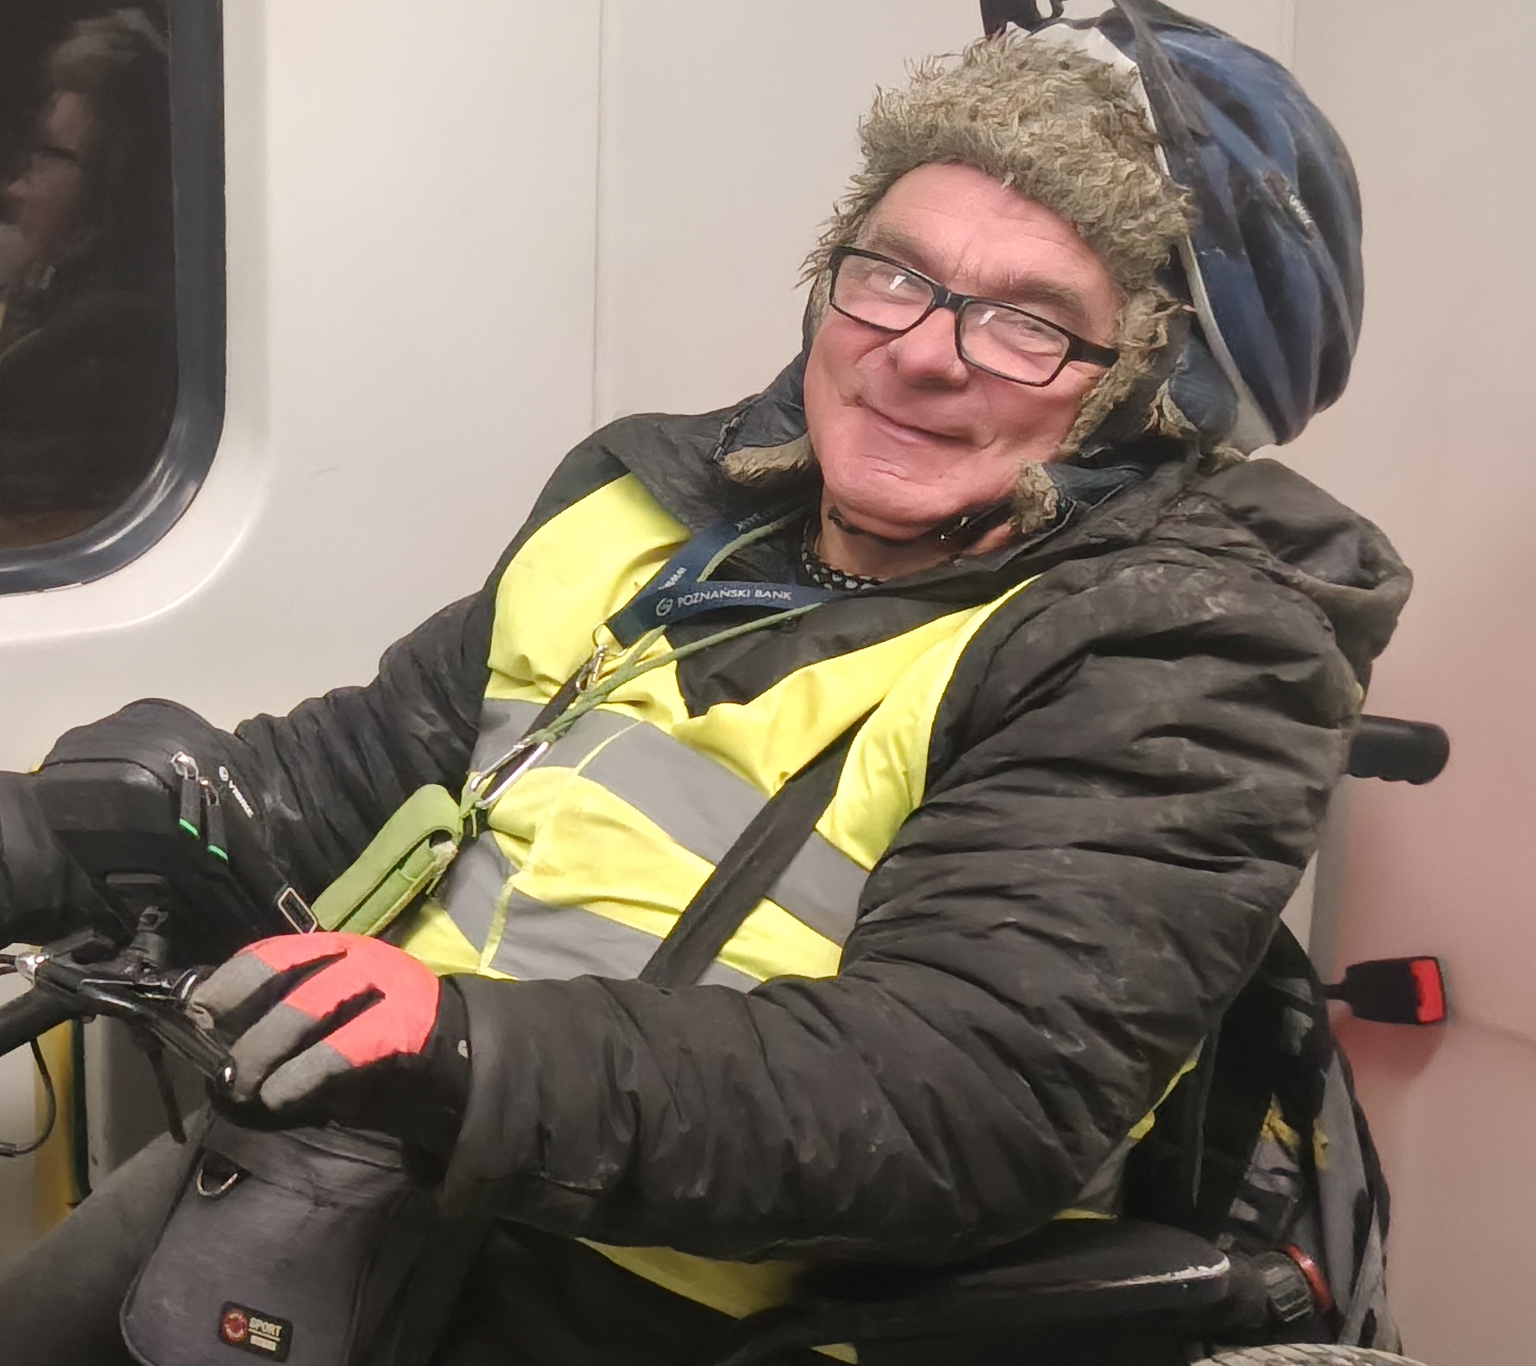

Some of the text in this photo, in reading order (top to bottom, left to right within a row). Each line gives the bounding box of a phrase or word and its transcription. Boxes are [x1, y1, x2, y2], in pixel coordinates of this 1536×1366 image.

[677, 586, 793, 608] POZNAŃSKI BANK
[249, 1317, 282, 1337] SPORT
